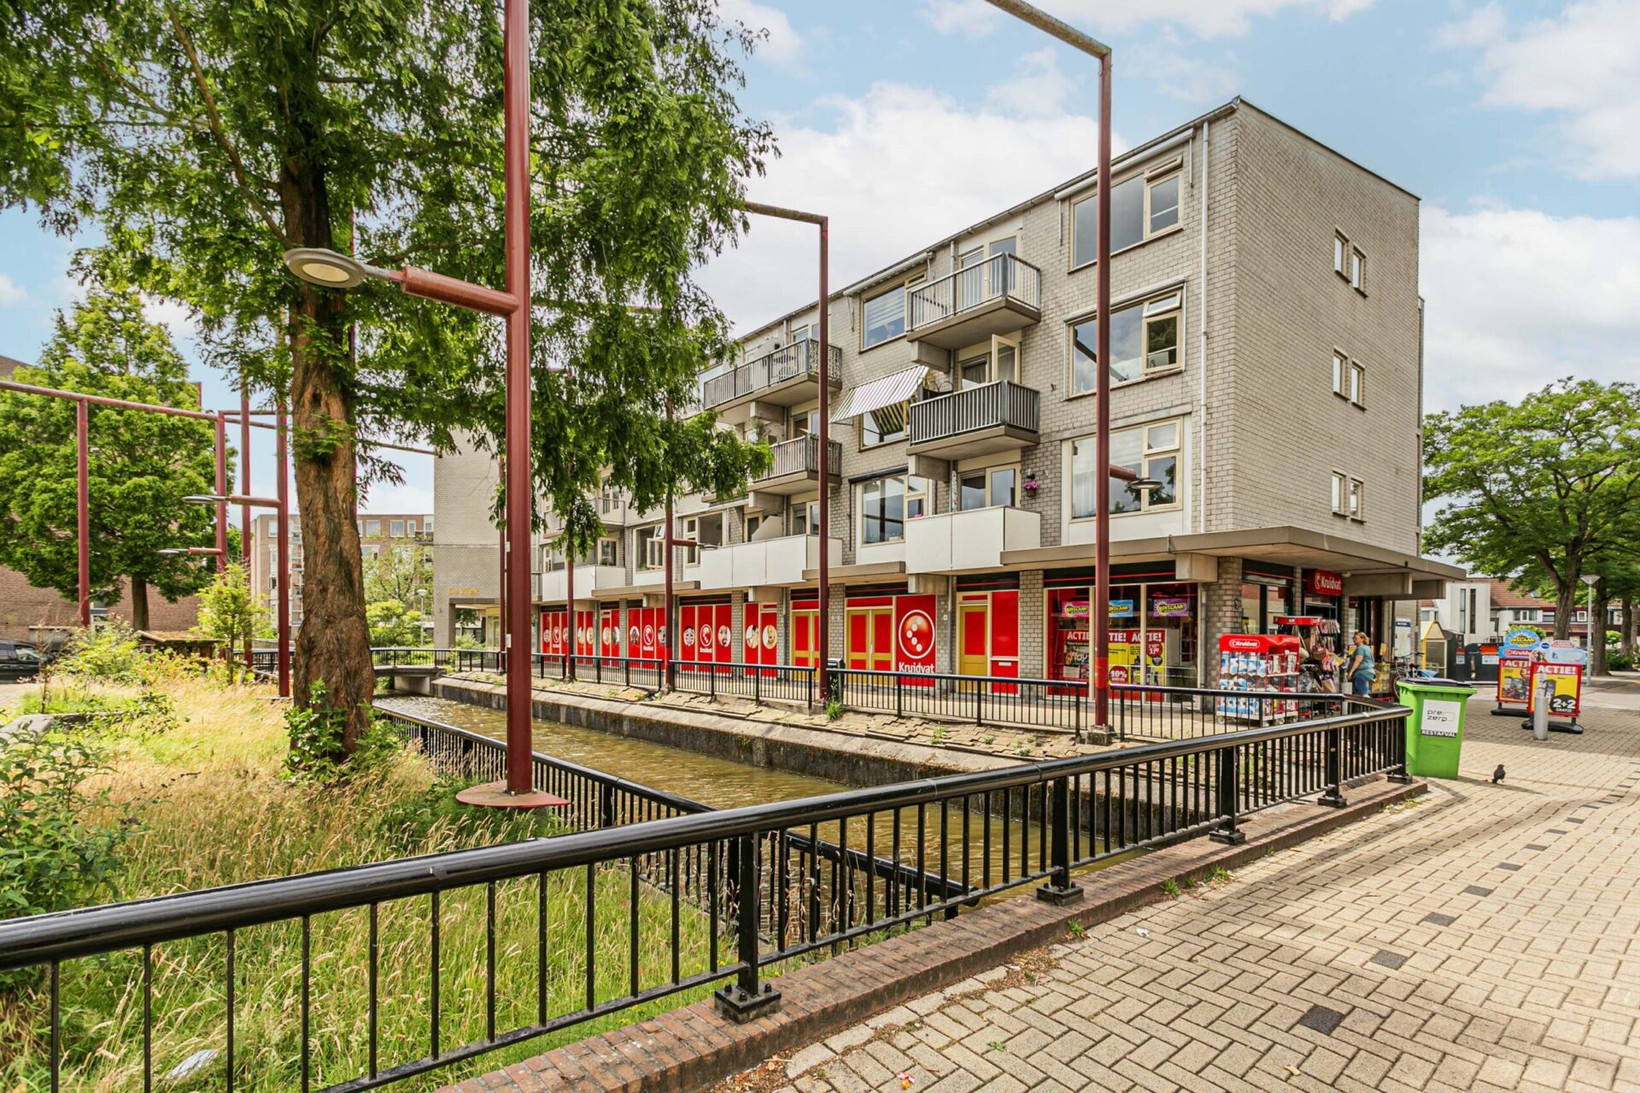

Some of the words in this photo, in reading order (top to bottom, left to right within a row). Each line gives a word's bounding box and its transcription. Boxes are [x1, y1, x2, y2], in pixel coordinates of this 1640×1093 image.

[1321, 576, 1341, 590] Kruidvat
[1109, 632, 1126, 641] TIE!
[899, 661, 934, 674] Kruidvat
[1537, 665, 1576, 674] ACTIE!
[1553, 698, 1576, 709] 2+2
